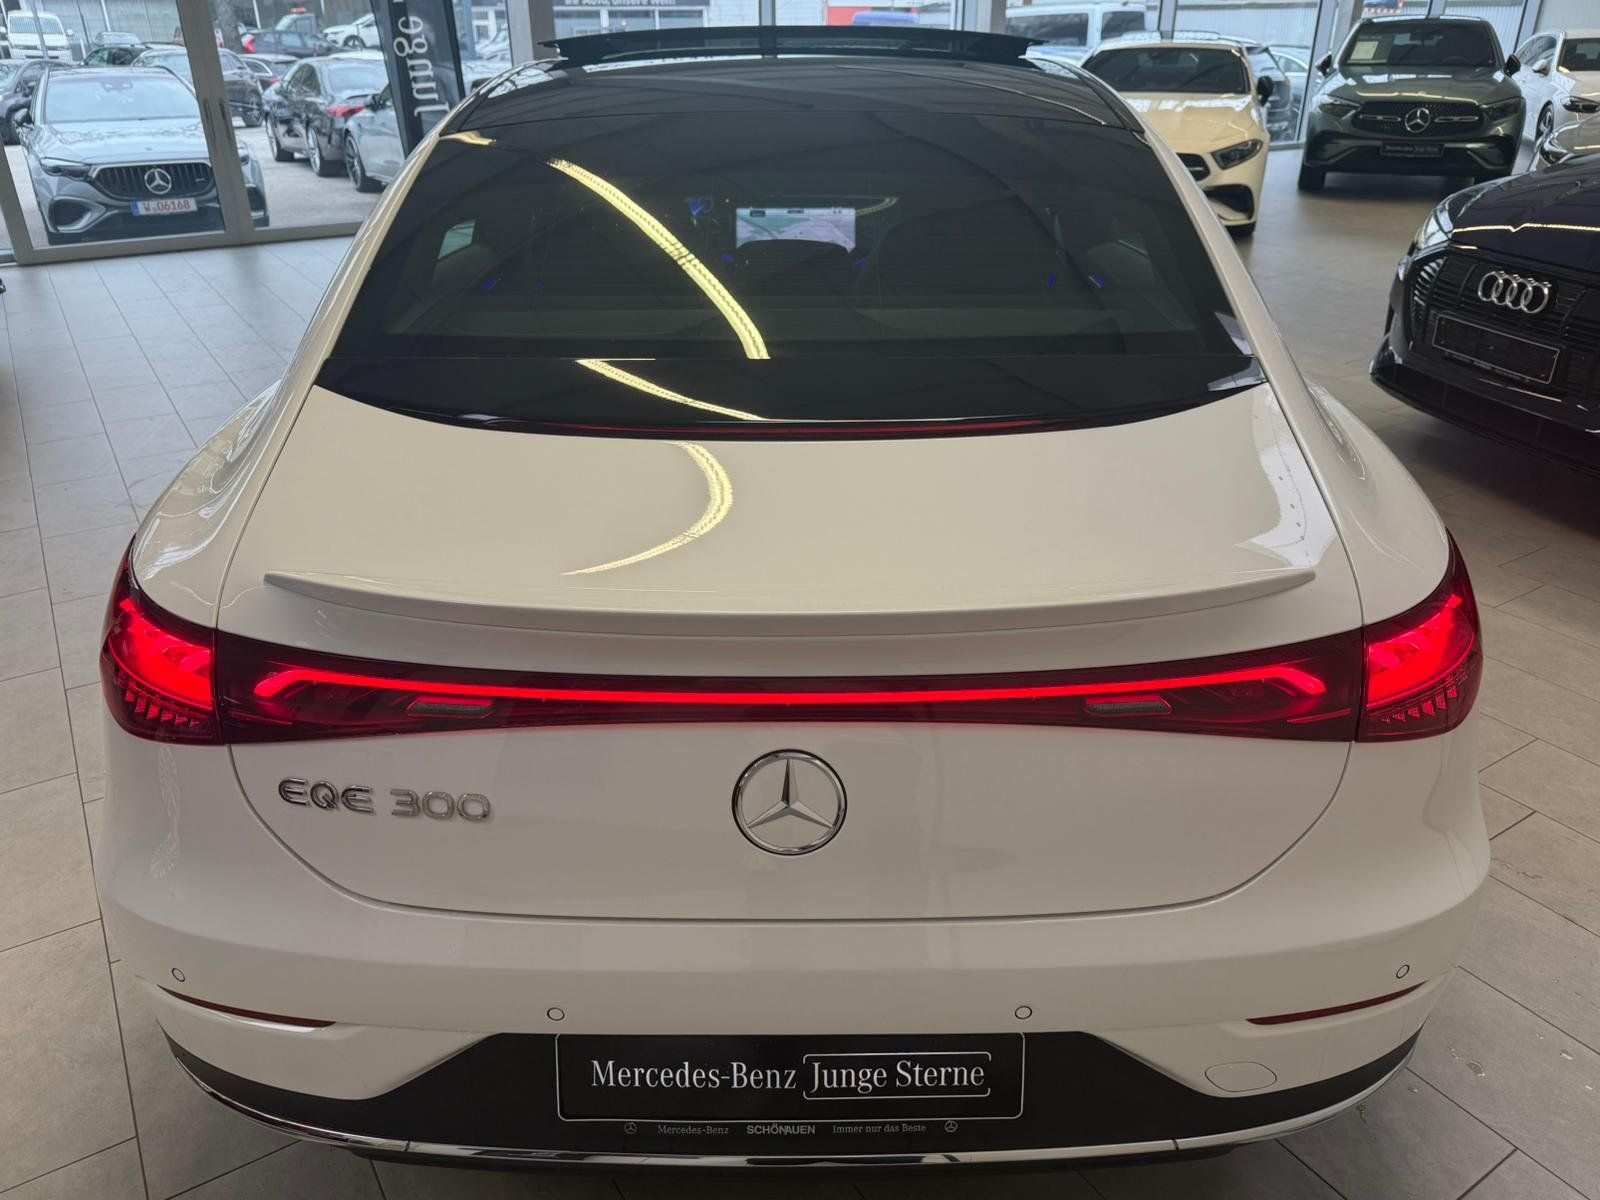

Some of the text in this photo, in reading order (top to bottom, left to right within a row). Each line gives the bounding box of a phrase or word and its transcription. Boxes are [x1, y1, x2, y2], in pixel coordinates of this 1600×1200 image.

[278, 776, 492, 821] EQE 300
[591, 1060, 984, 1094] Mercedes-Benz Junge Sterne
[657, 1123, 927, 1135] Mercedes-Benz SCHÖNAUEN Immer nur das Beste
